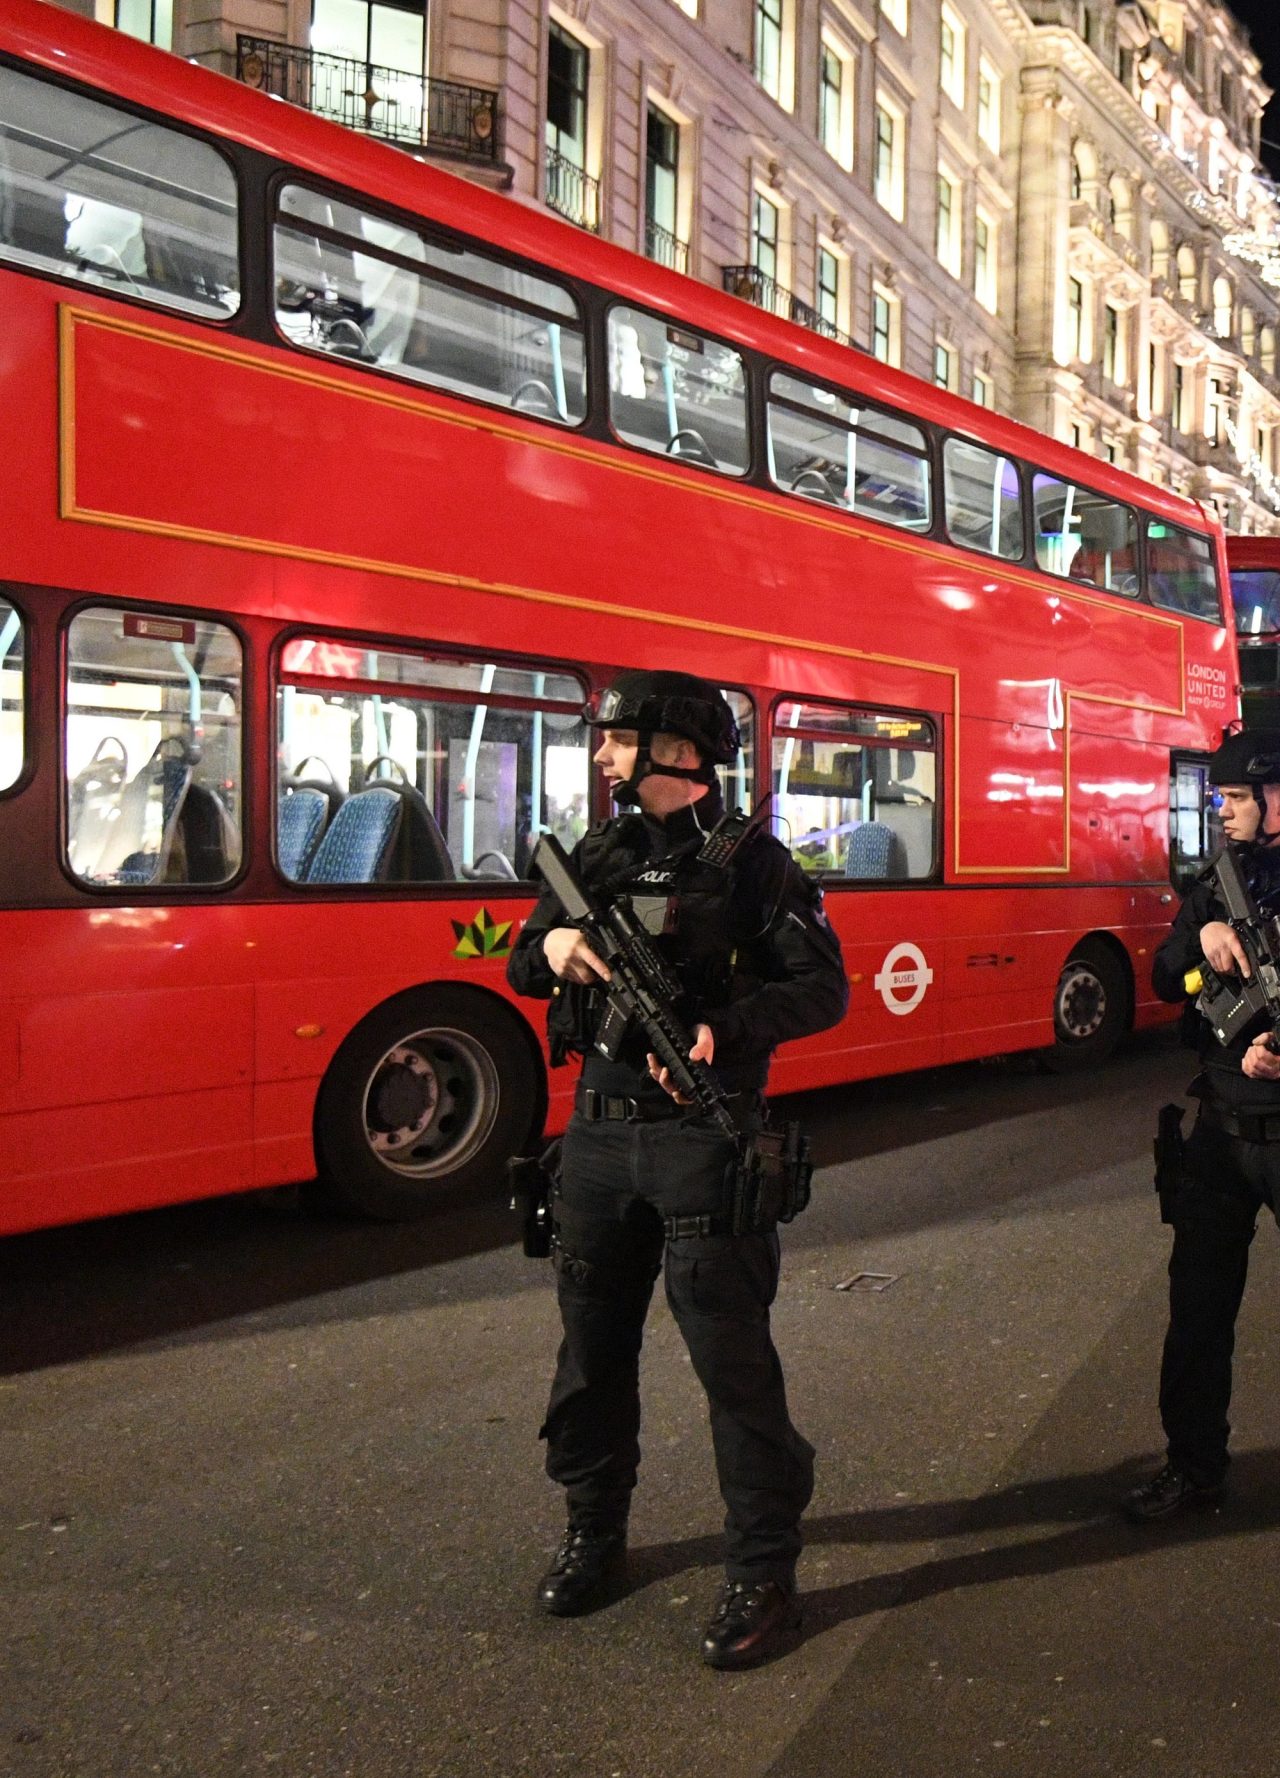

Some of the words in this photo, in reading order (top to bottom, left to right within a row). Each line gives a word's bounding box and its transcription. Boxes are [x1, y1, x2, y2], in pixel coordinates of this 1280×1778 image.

[1187, 663, 1226, 683] LONDON
[1187, 679, 1226, 699] UNITED
[894, 974, 915, 984] BUSES
